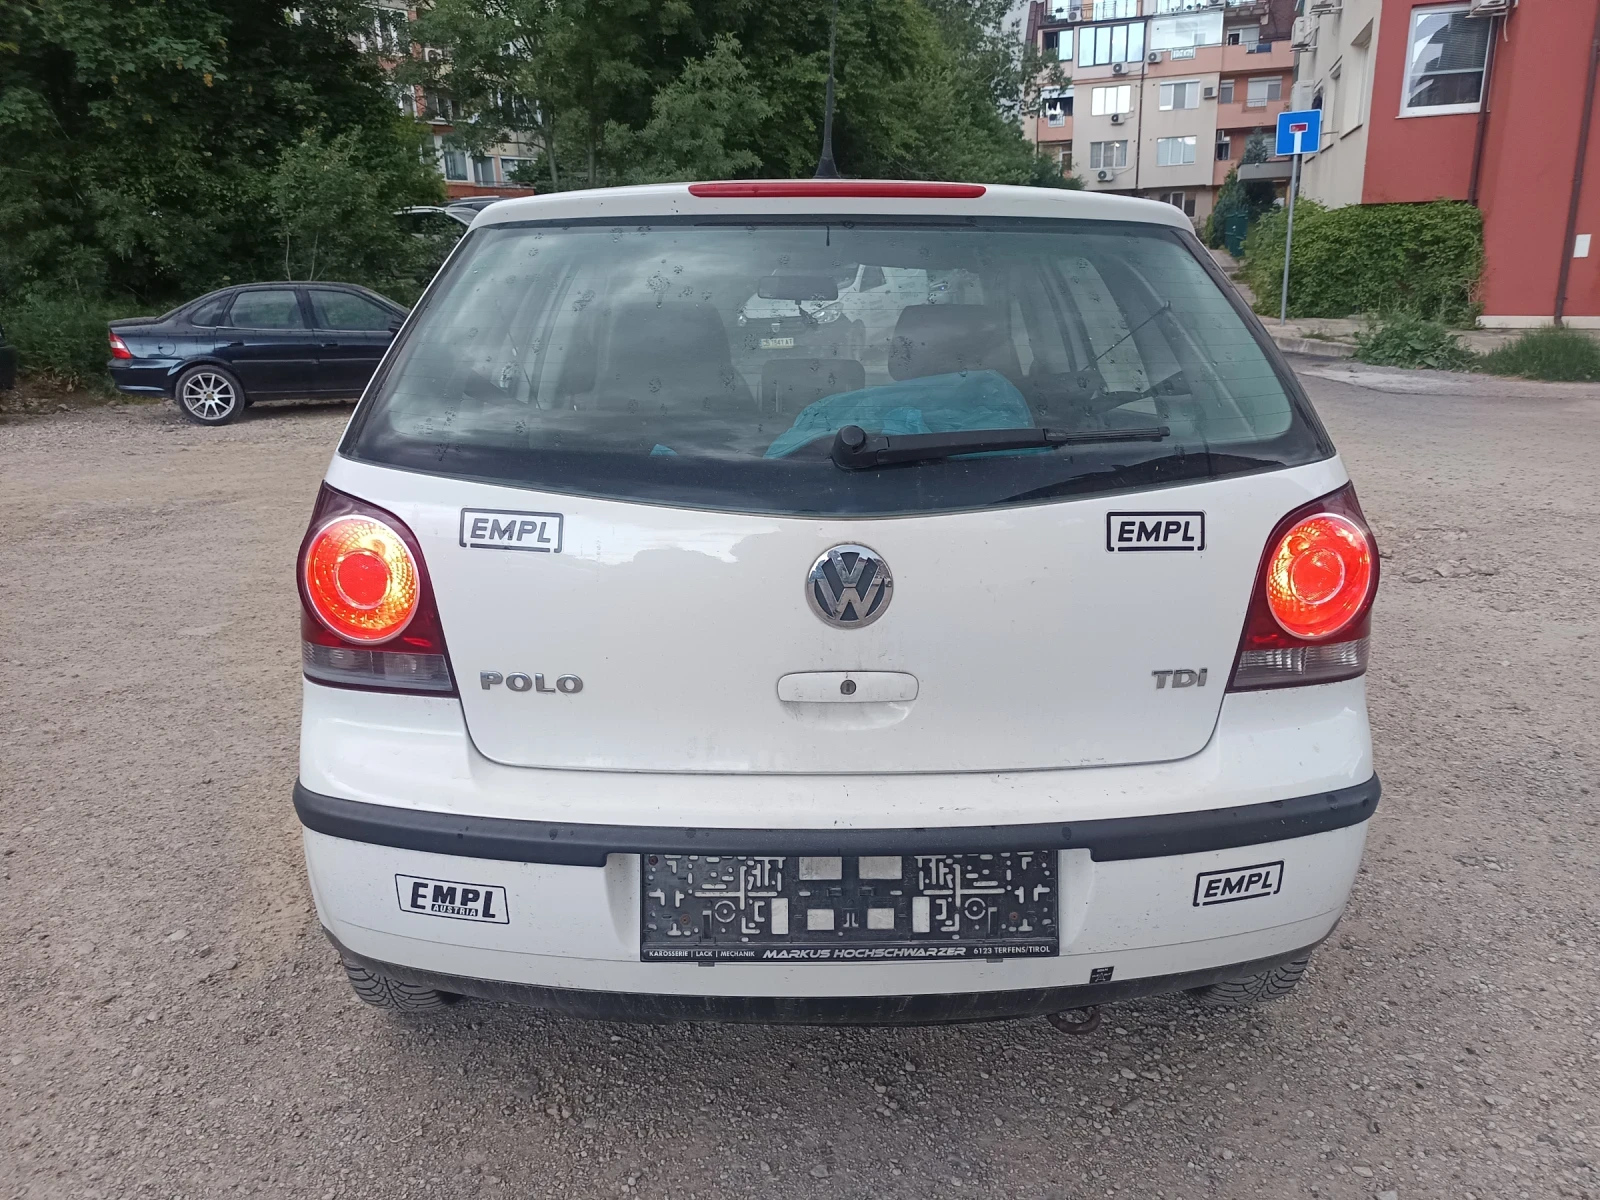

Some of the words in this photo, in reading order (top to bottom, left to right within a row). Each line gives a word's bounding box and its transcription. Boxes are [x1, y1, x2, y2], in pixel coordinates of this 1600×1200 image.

[470, 517, 551, 543] EMPL
[1117, 520, 1195, 542] EMPL
[479, 670, 584, 694] POLO
[1151, 667, 1208, 690] TDI
[1203, 870, 1273, 899] EMPL
[410, 881, 496, 918] EMPL
[432, 904, 477, 916] AUSTRIA
[648, 949, 689, 958] KAROSSERIE
[695, 949, 713, 957] LACK
[720, 949, 755, 958] MECHANIK
[762, 949, 831, 959] MARKUS
[833, 947, 967, 959] HOCHSCHWARZER
[973, 946, 993, 955] 6123
[994, 945, 1051, 954] TERFENS/TIROL
